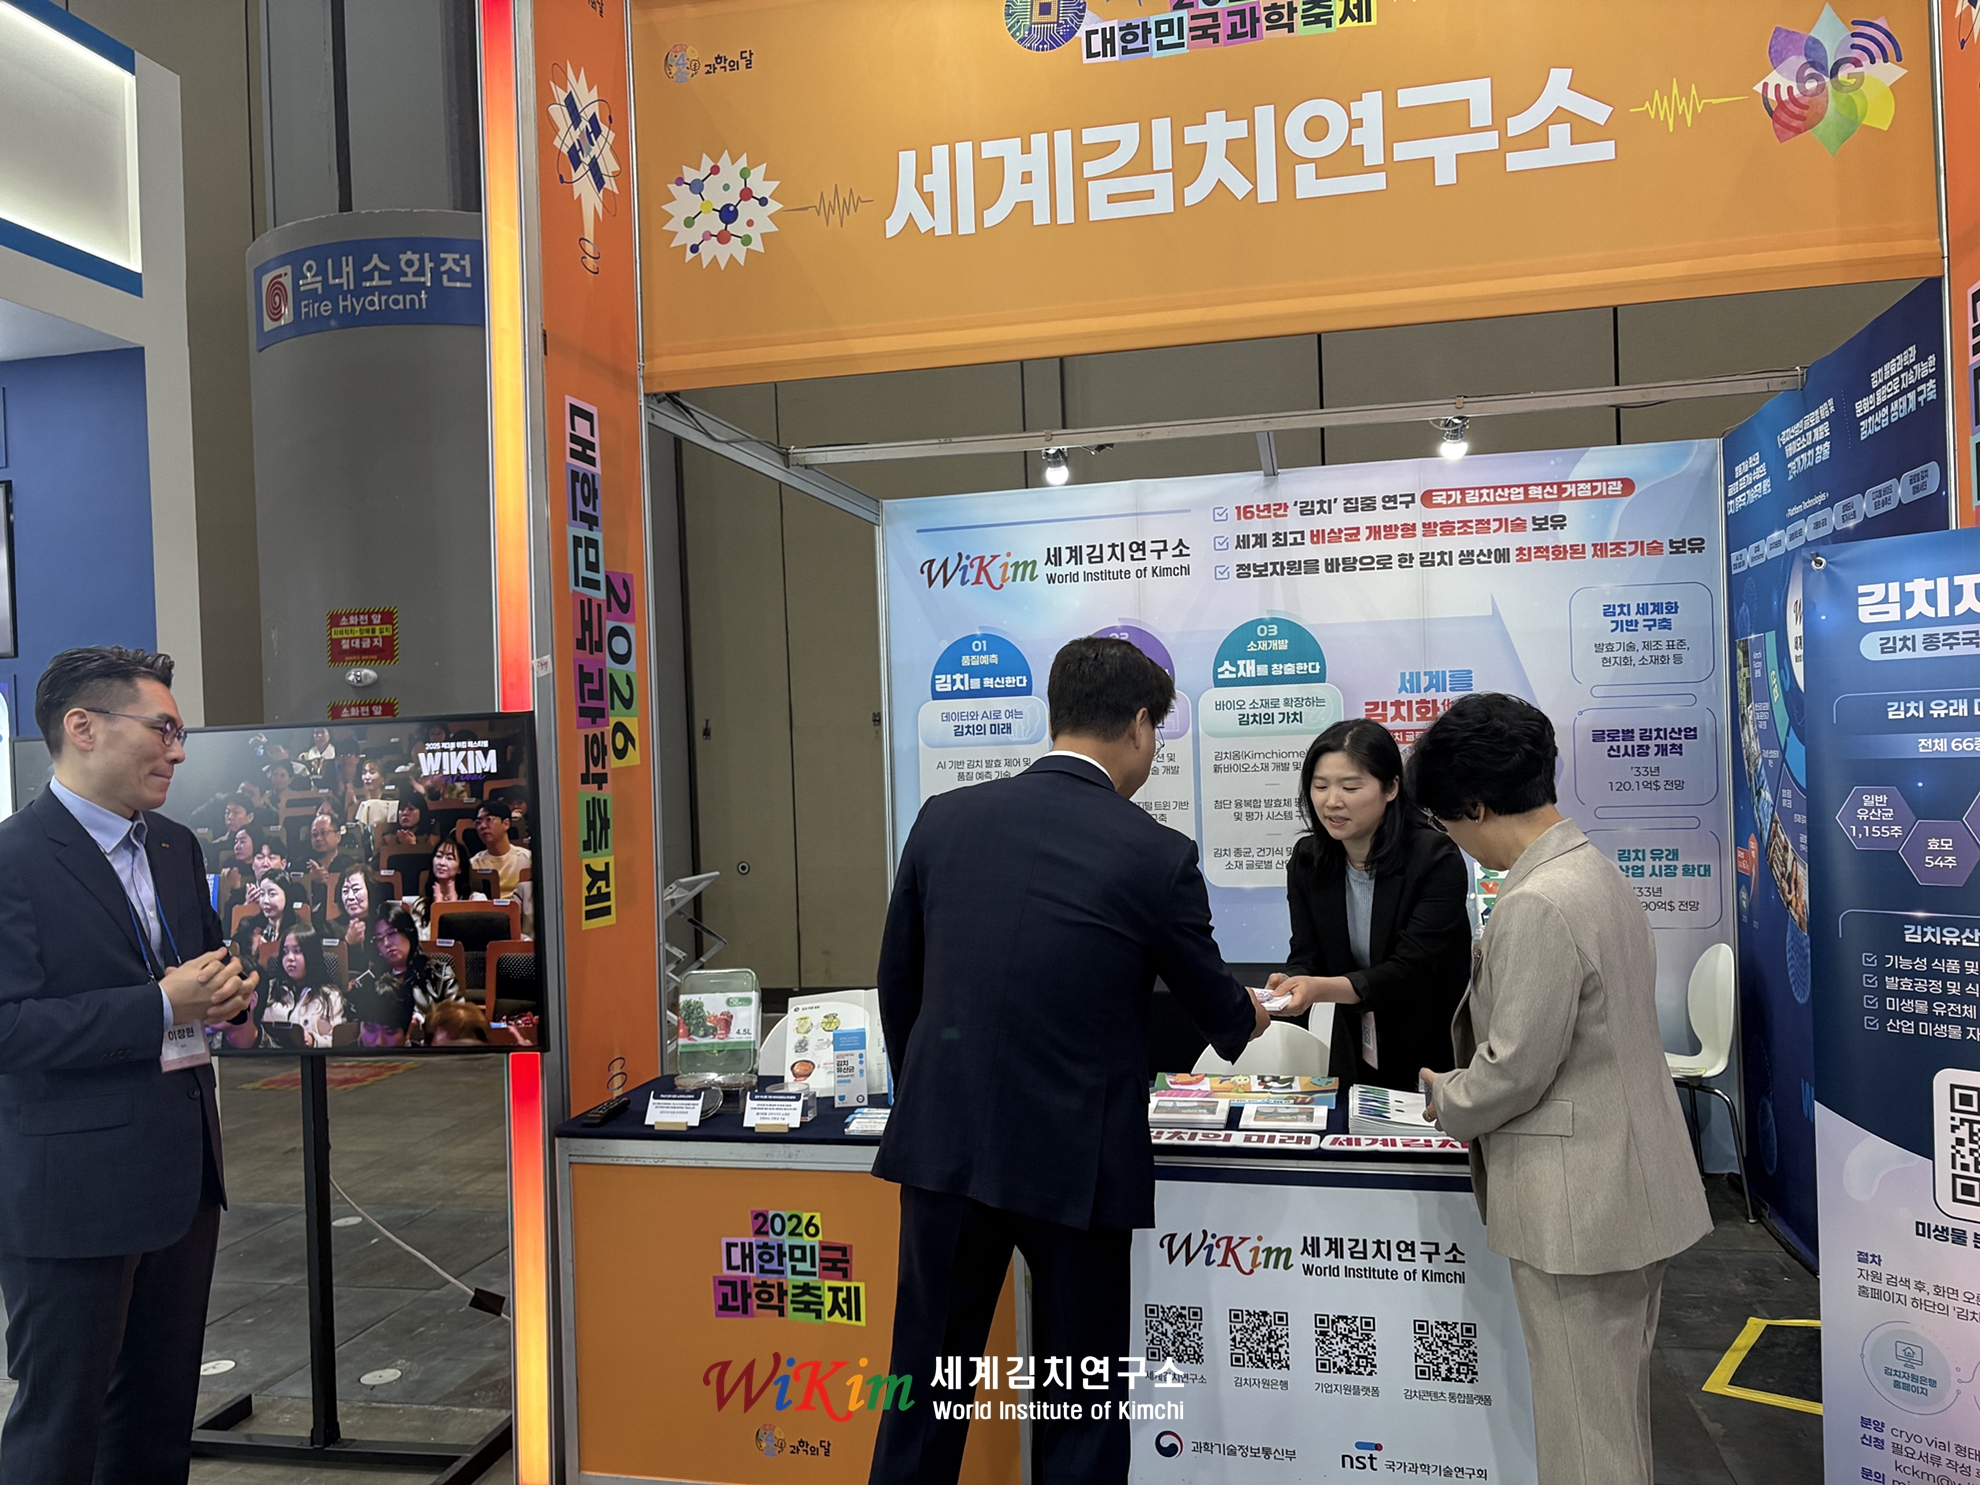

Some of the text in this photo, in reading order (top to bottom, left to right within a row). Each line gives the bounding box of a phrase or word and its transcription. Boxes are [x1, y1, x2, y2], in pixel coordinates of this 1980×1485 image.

[1085, 0, 1373, 59] 대한민국과학축제
[704, 49, 754, 75] 과학의 달
[1796, 56, 1864, 98] 6G
[885, 67, 1616, 239] 세계김치연구소
[299, 251, 473, 295] 옥내소화전
[300, 290, 429, 320] Fire Hydrant
[1917, 378, 1937, 407] 구축
[1235, 481, 1623, 521] 16년간 집중 연구 국가 김치산업 혁신 거점기관
[1234, 514, 1567, 551] 세계 최고 비살균 개방형 발효조절기술 보유
[1044, 538, 1191, 568] 세계김치연구소
[1235, 537, 1706, 580] 정보자원을 바탕으로 한 김치 생산에 최적화된 제조기술 보유
[919, 550, 1039, 591] WiKim
[1045, 563, 1191, 585] World Institute of Kimchi
[1602, 600, 1679, 618] 김치 세계화
[339, 614, 369, 626] 소화전
[1610, 617, 1673, 633] 기반 구축
[1257, 624, 1278, 637] 03
[341, 636, 383, 650] 절대금지
[971, 640, 987, 652] 01
[1246, 639, 1289, 652] 소재개발
[1594, 641, 1639, 654] 발효기술,
[1878, 635, 1917, 655] 김치
[568, 402, 613, 922] 대한민국과학축제
[606, 575, 636, 761] 2026
[961, 654, 998, 666] 품질예측
[1217, 659, 1321, 679] 소재를 창출한다
[935, 673, 1028, 692] 김치를 혁신한다
[1398, 669, 1473, 694] 세계를
[341, 706, 370, 717] 소화전
[1214, 696, 1326, 711] 바이오 소재로 확장하는
[1887, 701, 1924, 719] 김치
[1929, 698, 1968, 718] 유래
[941, 708, 1024, 723] 데이터와 AI로 여는
[1238, 711, 1303, 726] 김치의 가치
[953, 722, 1012, 737] 김치의 미래
[1591, 726, 1698, 743] 글로벌 김치산업
[1606, 743, 1684, 759] 신시장 개척
[1917, 737, 1947, 753] 전체
[418, 749, 497, 776] WIKIM
[1608, 779, 1685, 792] 120.1억$ 전망
[1862, 793, 1888, 807] 일반
[1856, 808, 1894, 821] 유산균
[1850, 824, 1903, 839] 1,155주
[1927, 837, 1953, 851] 효모
[1617, 848, 1679, 862] 김치 유래
[1924, 855, 1957, 869] 54주
[1648, 863, 1711, 878] 시장 확대
[1678, 900, 1700, 911] 전망
[1884, 954, 1961, 974] 기능성 식품
[1885, 975, 1943, 994] 발효공정
[1885, 997, 1977, 1020] 미생물 유전체
[1885, 1018, 1963, 1040] 산업 미생물
[1243, 1134, 1312, 1145] 미래
[753, 1212, 820, 1238] 2026
[1915, 1220, 1968, 1247] 미생물
[1159, 1229, 1294, 1276] WiKim
[1300, 1235, 1466, 1264] 세계김치연구소
[1856, 1250, 1882, 1267] 절차
[724, 1241, 851, 1279] 대한민국
[1302, 1262, 1466, 1285] World Institute of Kimchi
[1857, 1267, 1959, 1301] 자원 검색 화면
[716, 1279, 863, 1323] 과학축제
[1857, 1284, 1950, 1317] 홈페이지 하단의
[1233, 1376, 1289, 1391] 김치자원은행
[1883, 1366, 1938, 1389] 김치자원은행
[1314, 1382, 1381, 1398] 기업지원플랫폼
[1403, 1388, 1493, 1407] 김치콘텐츠 통합플랫폼
[1893, 1379, 1928, 1397] 홈페이지
[1860, 1415, 1951, 1453] 분양 cryo vial
[789, 1438, 820, 1456] 과학의
[1190, 1440, 1297, 1462] 과학기술정보통신부
[1860, 1432, 1972, 1477] 신청 필요서류 작성
[1341, 1451, 1378, 1471] nst
[1384, 1459, 1488, 1481] 국가과학기술연구회
[1860, 1466, 1885, 1485] 문의
